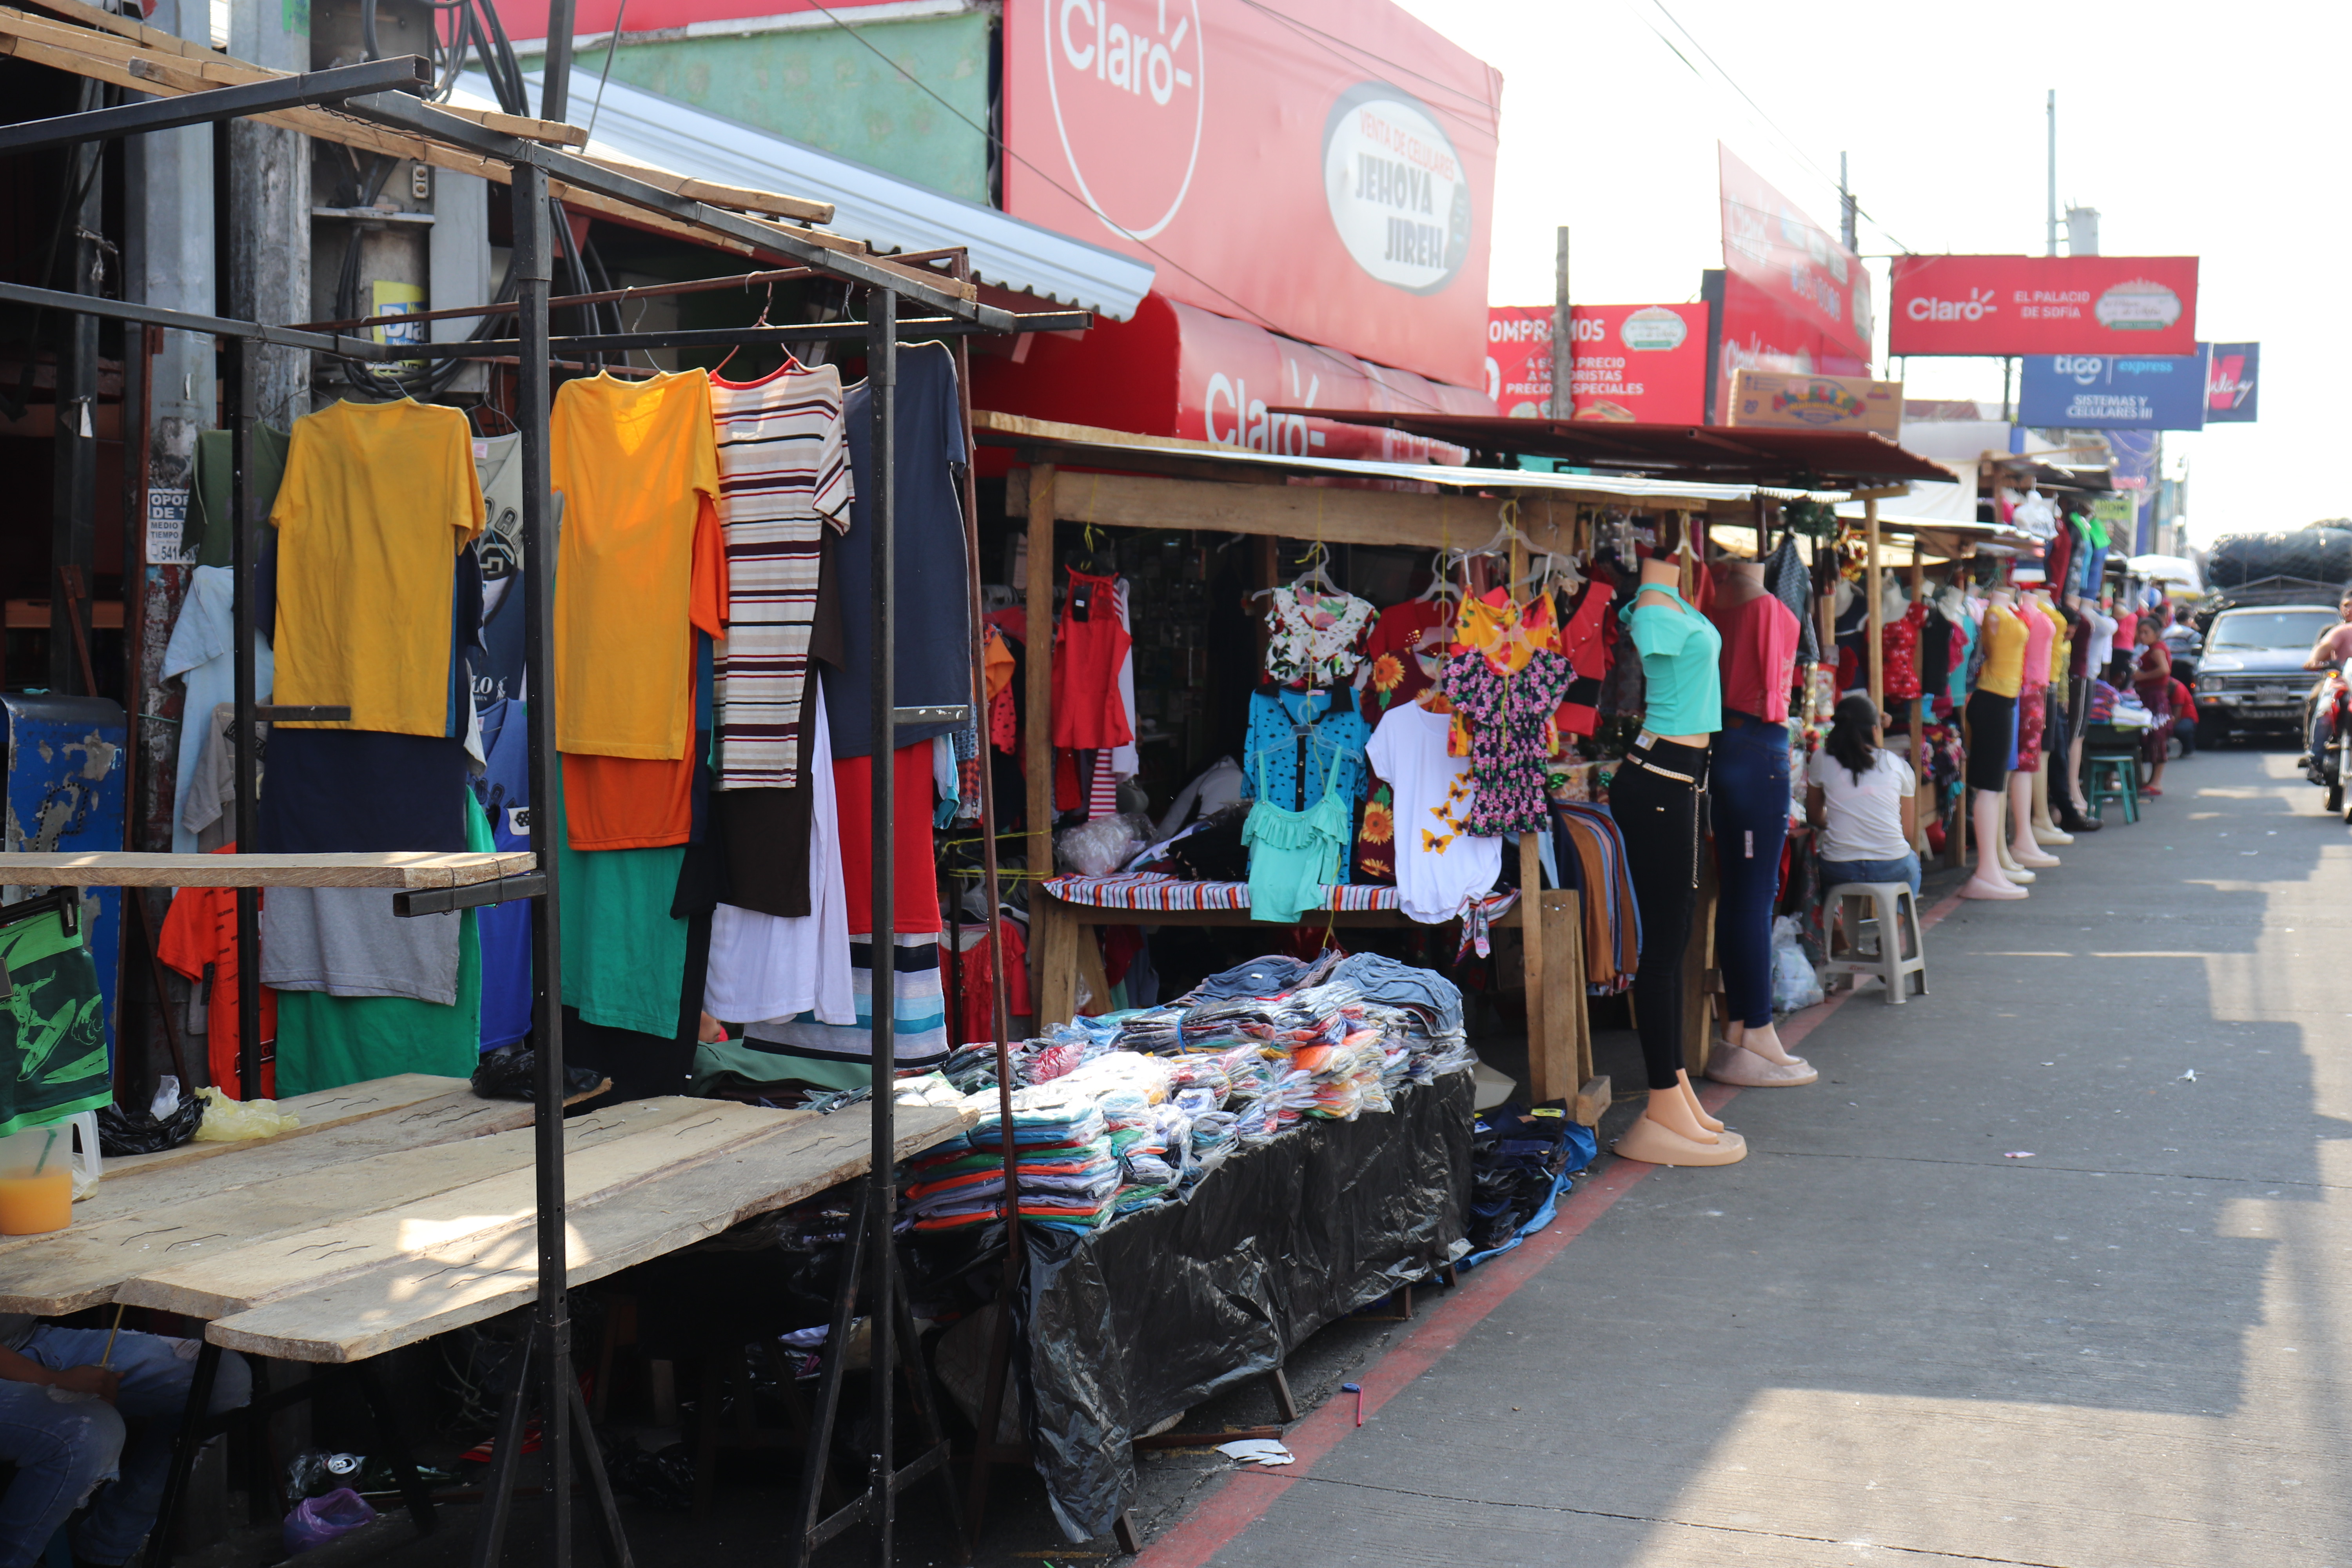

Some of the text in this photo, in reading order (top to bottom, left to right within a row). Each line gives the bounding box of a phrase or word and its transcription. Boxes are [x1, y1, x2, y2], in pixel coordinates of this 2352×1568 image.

[1060, 0, 1174, 106] Claro
[1360, 108, 1455, 181] VENTA DE CELULARES
[1356, 151, 1433, 215] JEHOVA
[1384, 216, 1444, 269] JIREH
[2014, 290, 2090, 303] EL PALACIO
[1907, 296, 1984, 321] Claro
[2022, 303, 2081, 318] DE SOFÍA
[1526, 358, 1535, 368] A
[1577, 357, 1626, 368] PRECIO
[2054, 354, 2102, 385] tigo
[2117, 359, 2173, 375] express
[1528, 370, 1537, 381] A
[2074, 394, 2149, 407] SISTEMAS Y
[1205, 372, 1309, 457] Claro
[2066, 406, 2138, 419] CELULARES
[152, 507, 174, 519] DE
